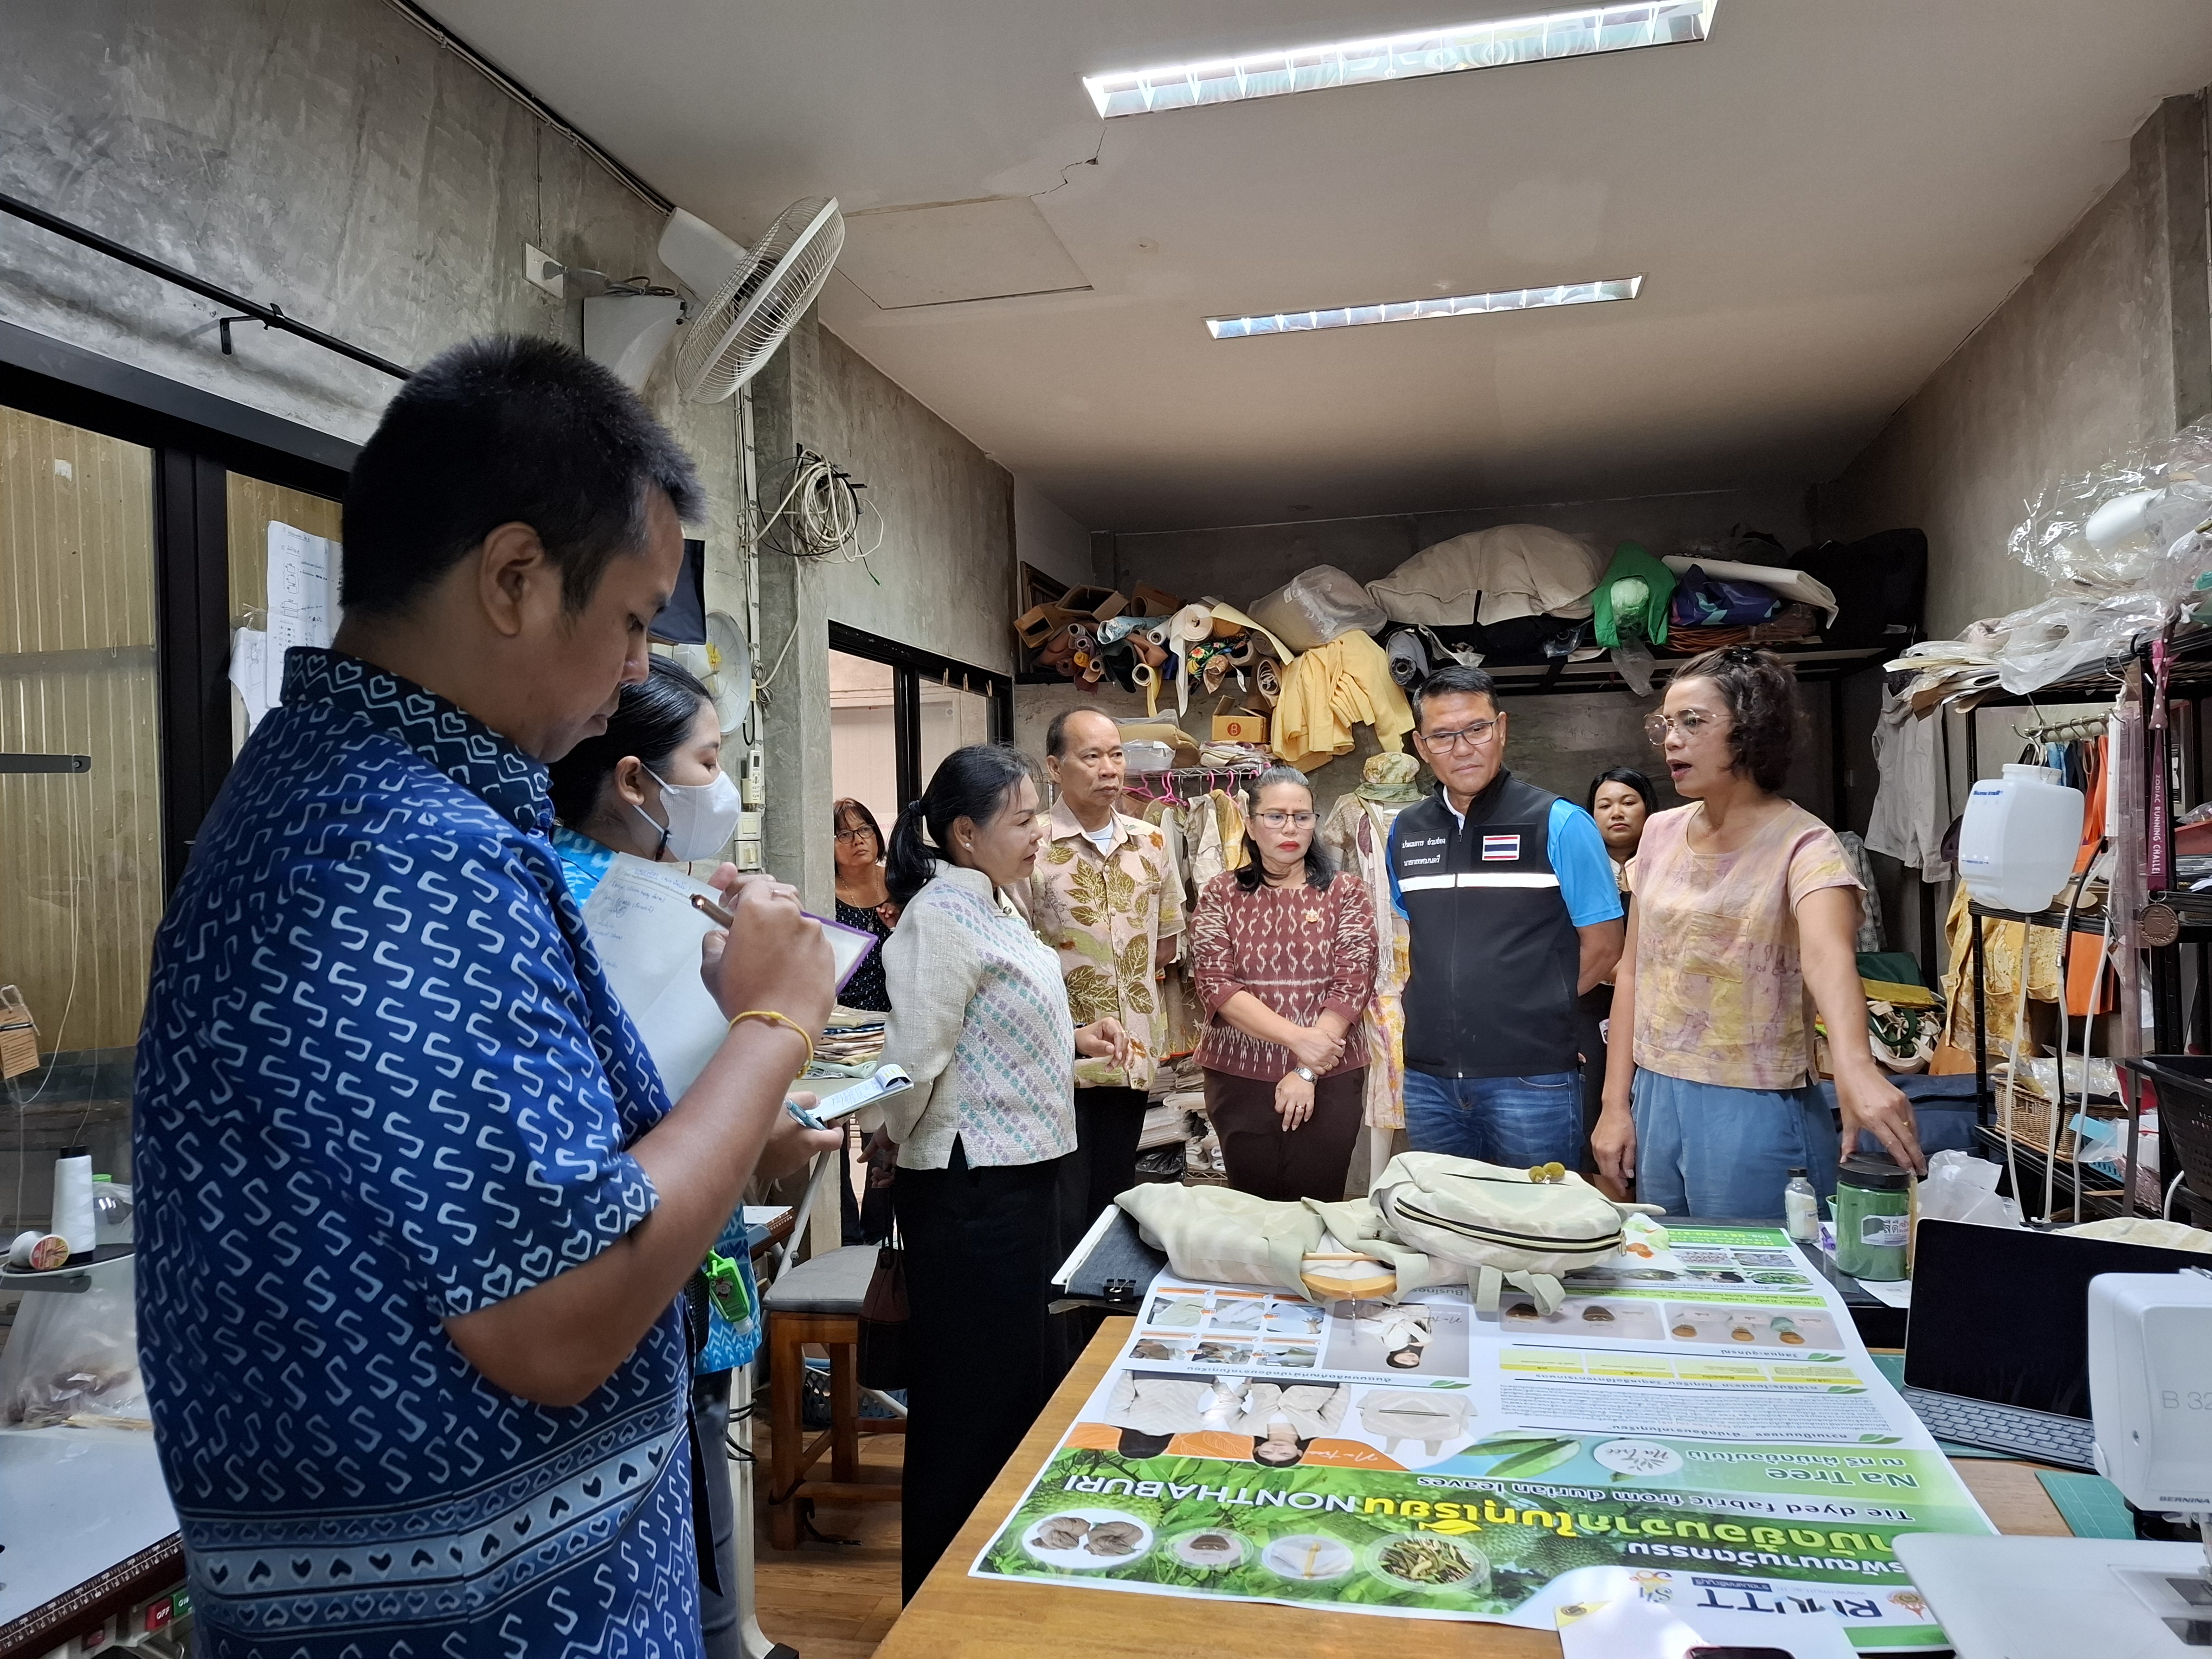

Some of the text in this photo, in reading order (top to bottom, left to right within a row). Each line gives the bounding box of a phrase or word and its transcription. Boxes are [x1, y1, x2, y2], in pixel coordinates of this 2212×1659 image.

[2162, 1390, 2179, 1409] B
[1643, 1448, 1669, 1461] Na
[1846, 1455, 1875, 1468] ทรี
[1765, 1468, 1916, 1488] Na Tree
[1064, 1474, 1356, 1513] NONTHABURI
[1417, 1476, 1912, 1522] Tie dyed fabric from durian leaves
[2159, 1496, 2210, 1504] BERNINA
[156, 1606, 170, 1619] OFF
